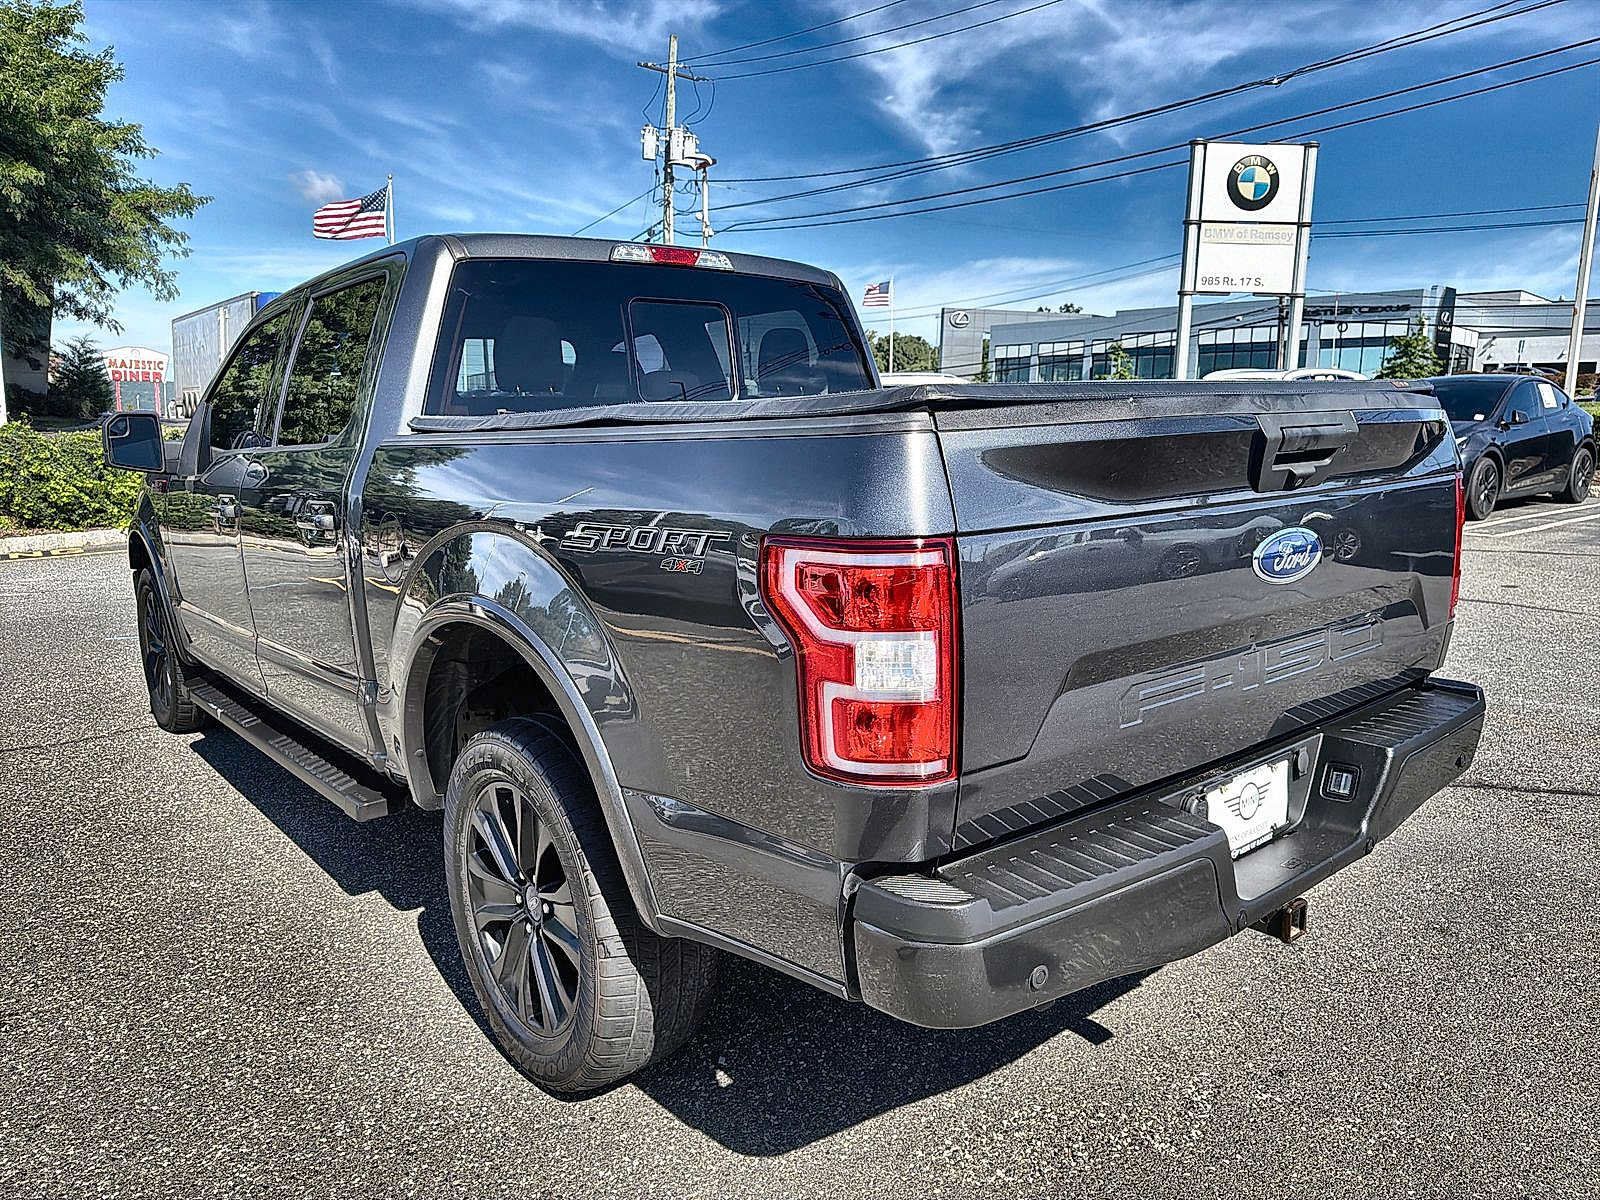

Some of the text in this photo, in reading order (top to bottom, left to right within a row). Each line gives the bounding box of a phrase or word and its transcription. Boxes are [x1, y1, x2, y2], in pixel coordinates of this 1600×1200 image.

[1232, 156, 1277, 175] BMW
[1203, 227, 1295, 241] BMW of Ramsey
[1201, 276, 1221, 286] 985
[1240, 277, 1252, 286] 17
[107, 358, 164, 370] MAJESTIC
[111, 370, 162, 383] DINER
[559, 521, 733, 559] SPORT
[1273, 540, 1312, 570] Ford
[1119, 614, 1385, 729] F-150
